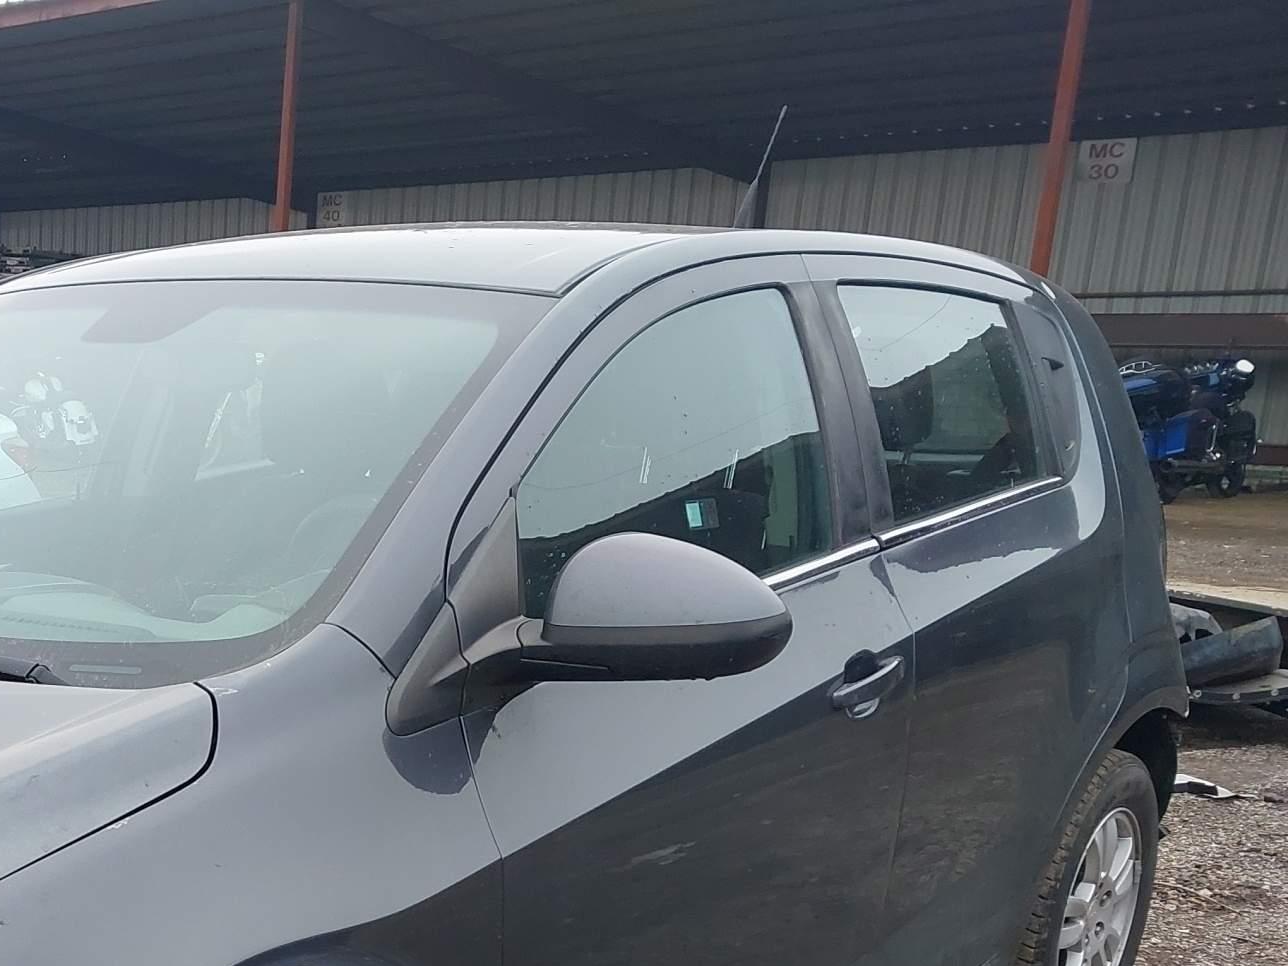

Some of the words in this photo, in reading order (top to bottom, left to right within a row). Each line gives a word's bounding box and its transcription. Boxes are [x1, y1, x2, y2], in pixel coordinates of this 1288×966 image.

[1089, 142, 1126, 159] MC
[1088, 163, 1119, 180] 30
[321, 193, 344, 208] MC
[322, 210, 341, 222] 40
